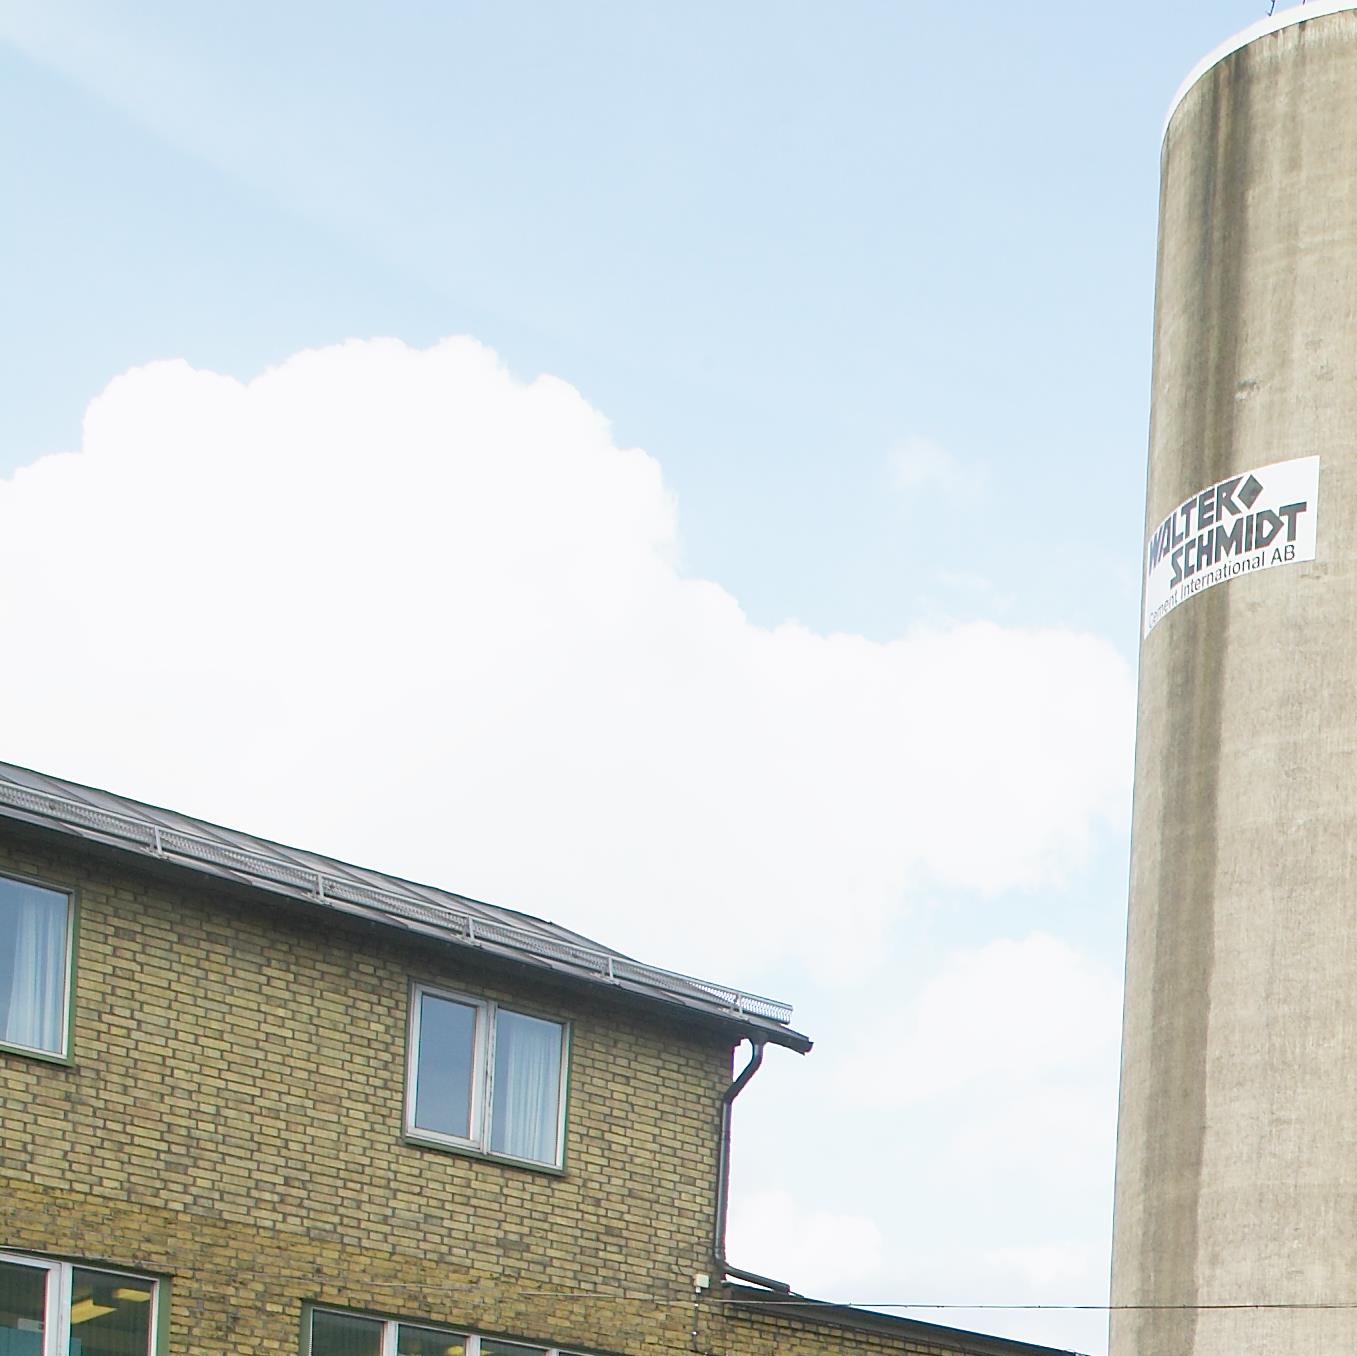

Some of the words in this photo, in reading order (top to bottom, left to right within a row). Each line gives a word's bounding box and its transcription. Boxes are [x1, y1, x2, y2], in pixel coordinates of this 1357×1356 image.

[1148, 474, 1244, 576] WALTER
[1169, 501, 1308, 589] SCHMIDT
[1180, 549, 1266, 602] International
[1270, 544, 1296, 565] AB
